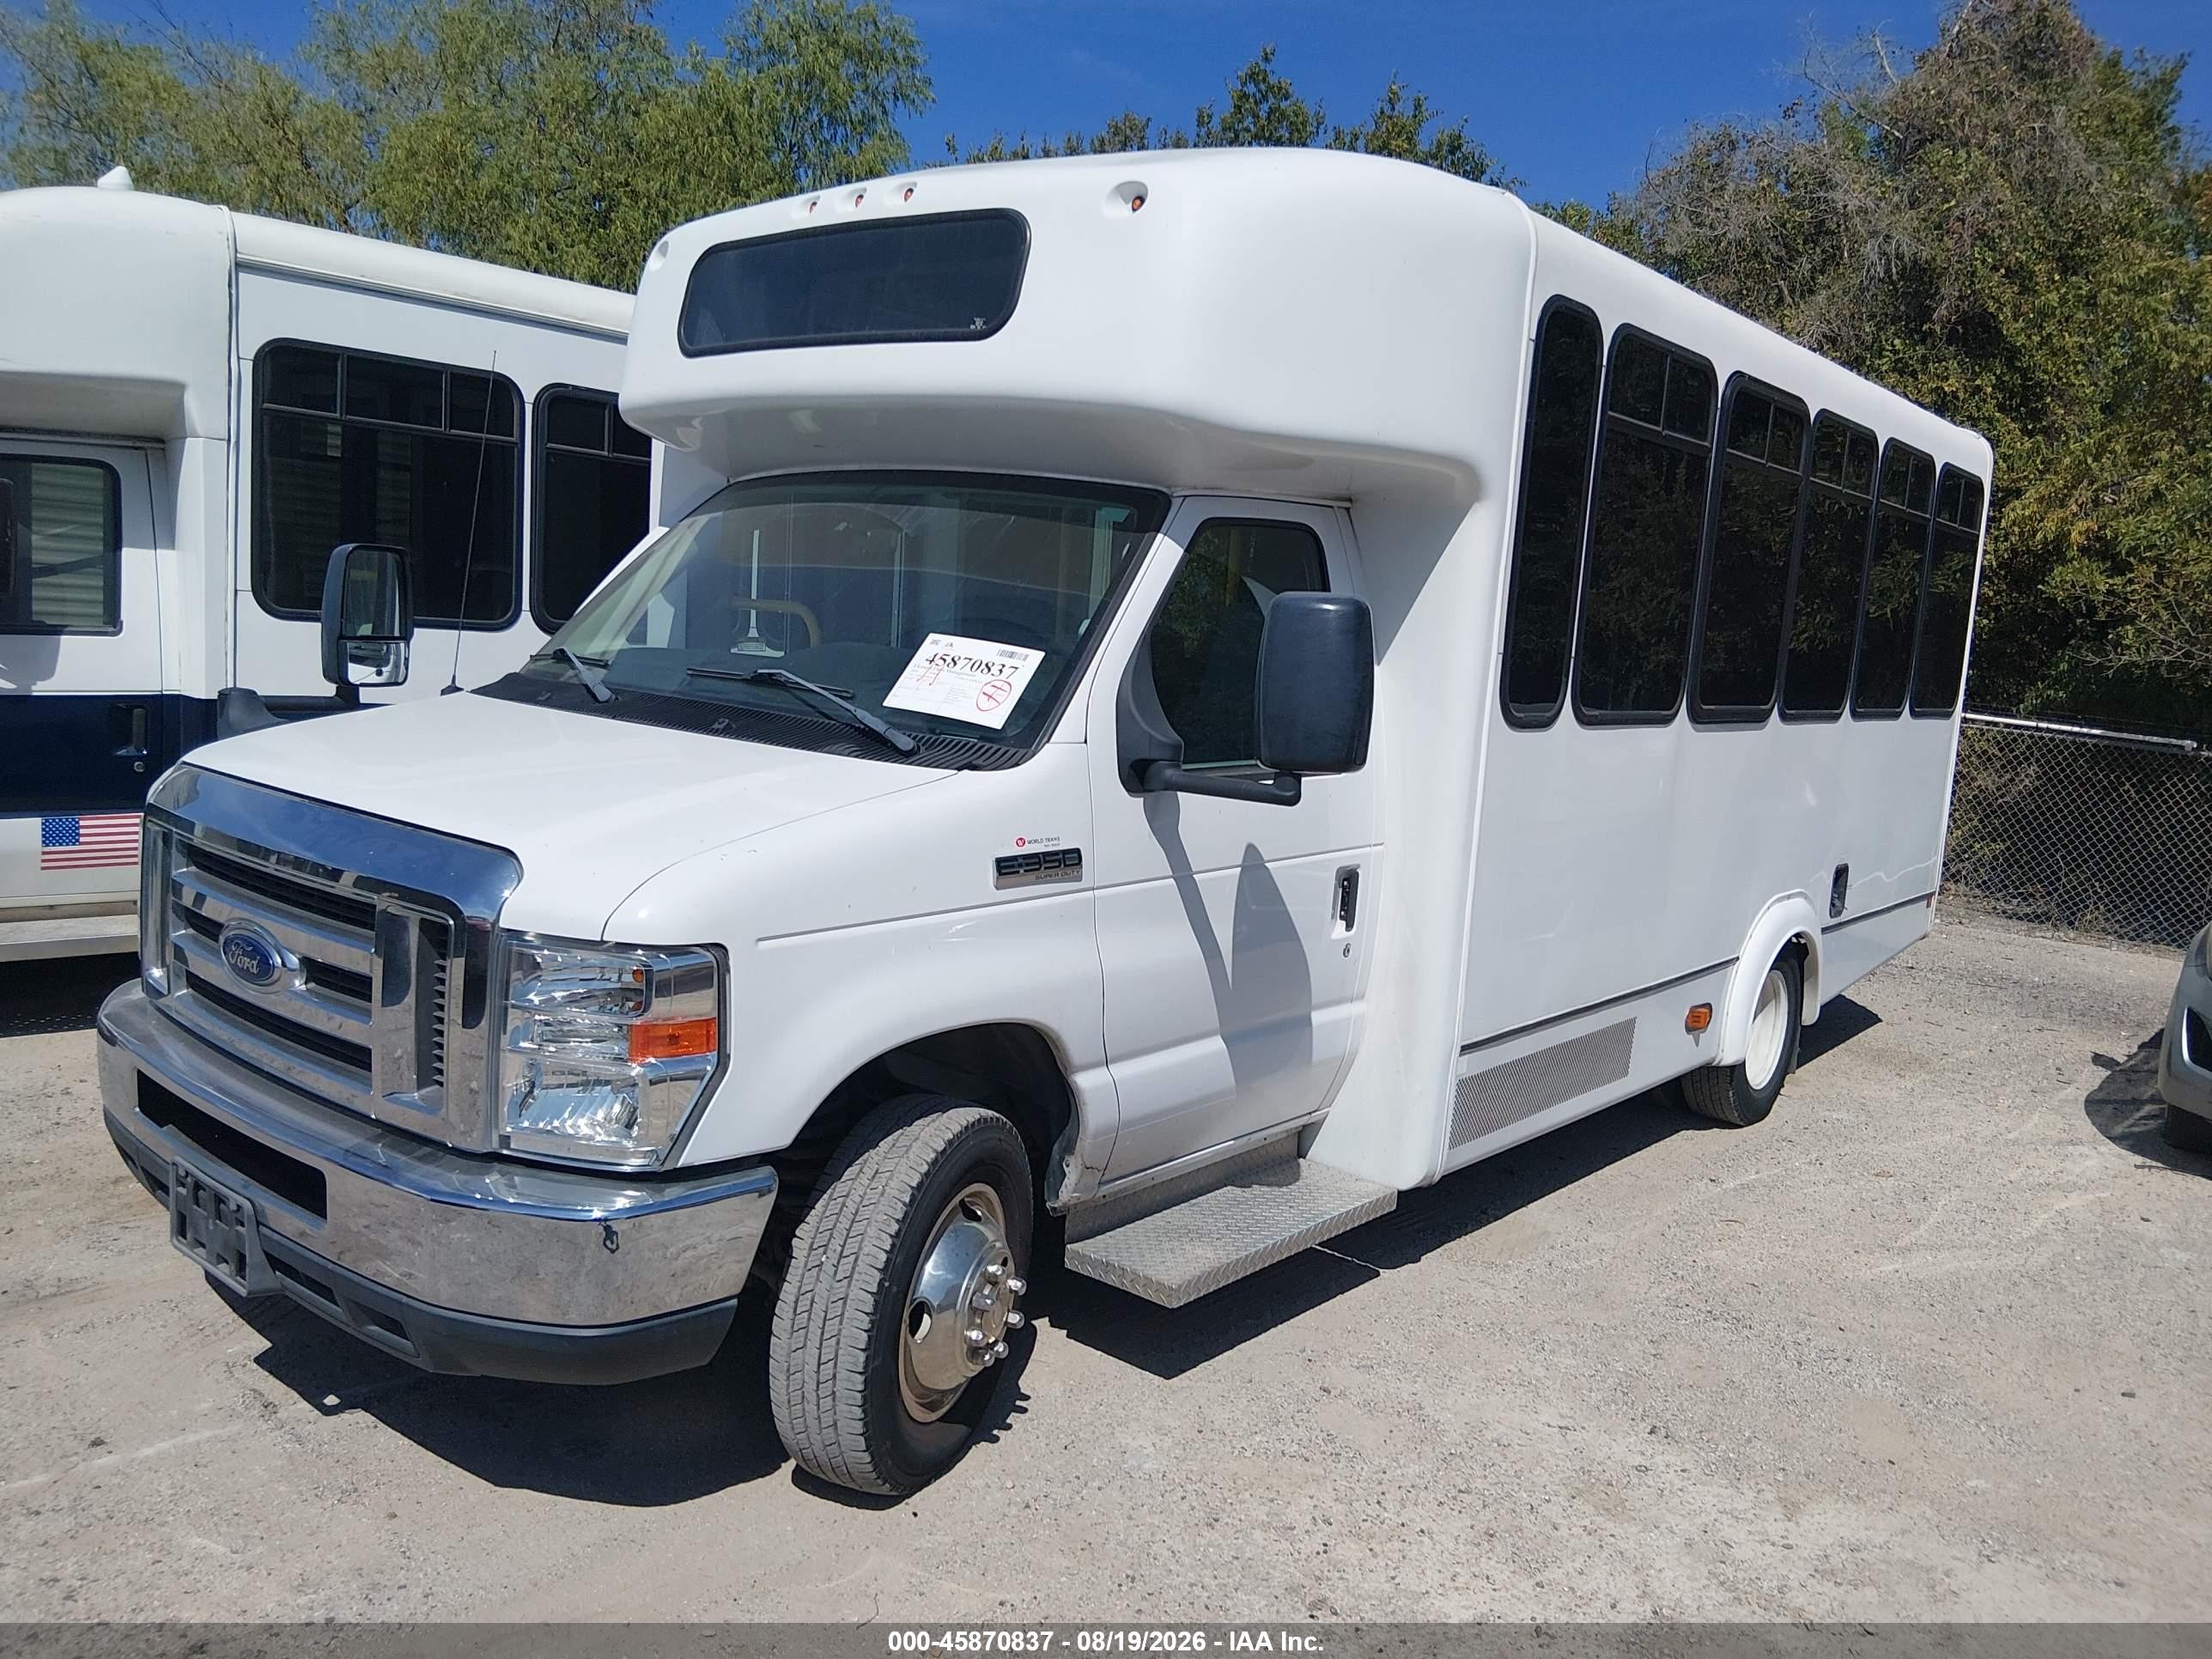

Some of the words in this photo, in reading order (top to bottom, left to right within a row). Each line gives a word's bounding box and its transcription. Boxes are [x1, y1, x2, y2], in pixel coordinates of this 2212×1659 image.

[925, 652, 1019, 680] 45870837
[1035, 871, 1060, 881] SUPER
[1060, 869, 1081, 878] DUTY
[228, 939, 261, 975] Ford
